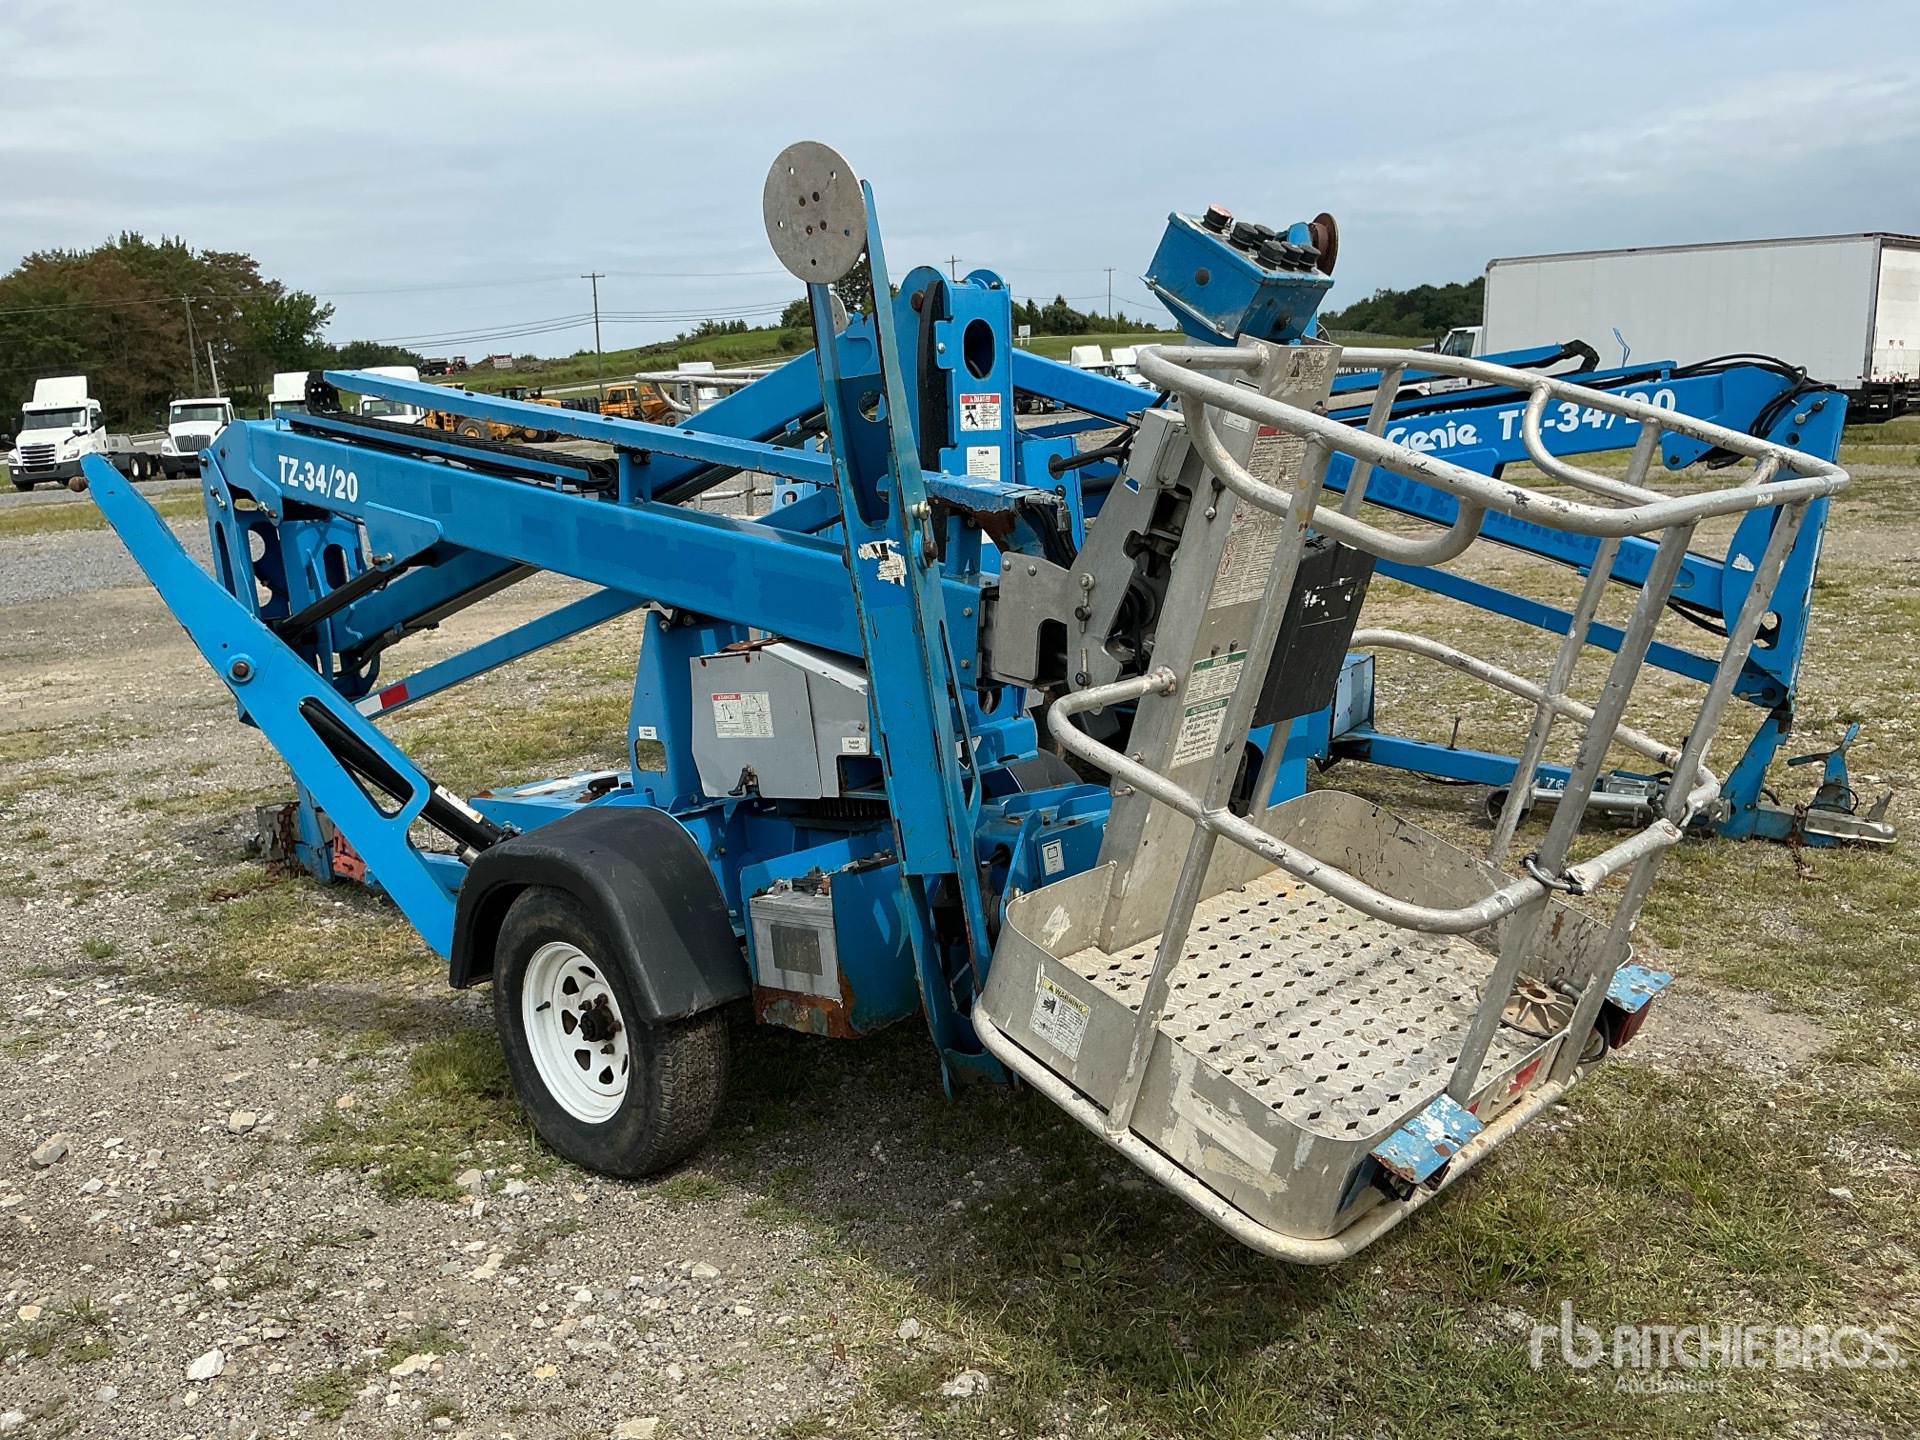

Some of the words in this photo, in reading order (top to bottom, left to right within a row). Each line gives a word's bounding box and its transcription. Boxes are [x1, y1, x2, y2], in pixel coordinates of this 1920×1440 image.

[1386, 419, 1478, 452] Genie
[278, 454, 359, 503] TZ-34/20
[1055, 987, 1084, 1012] WARNING
